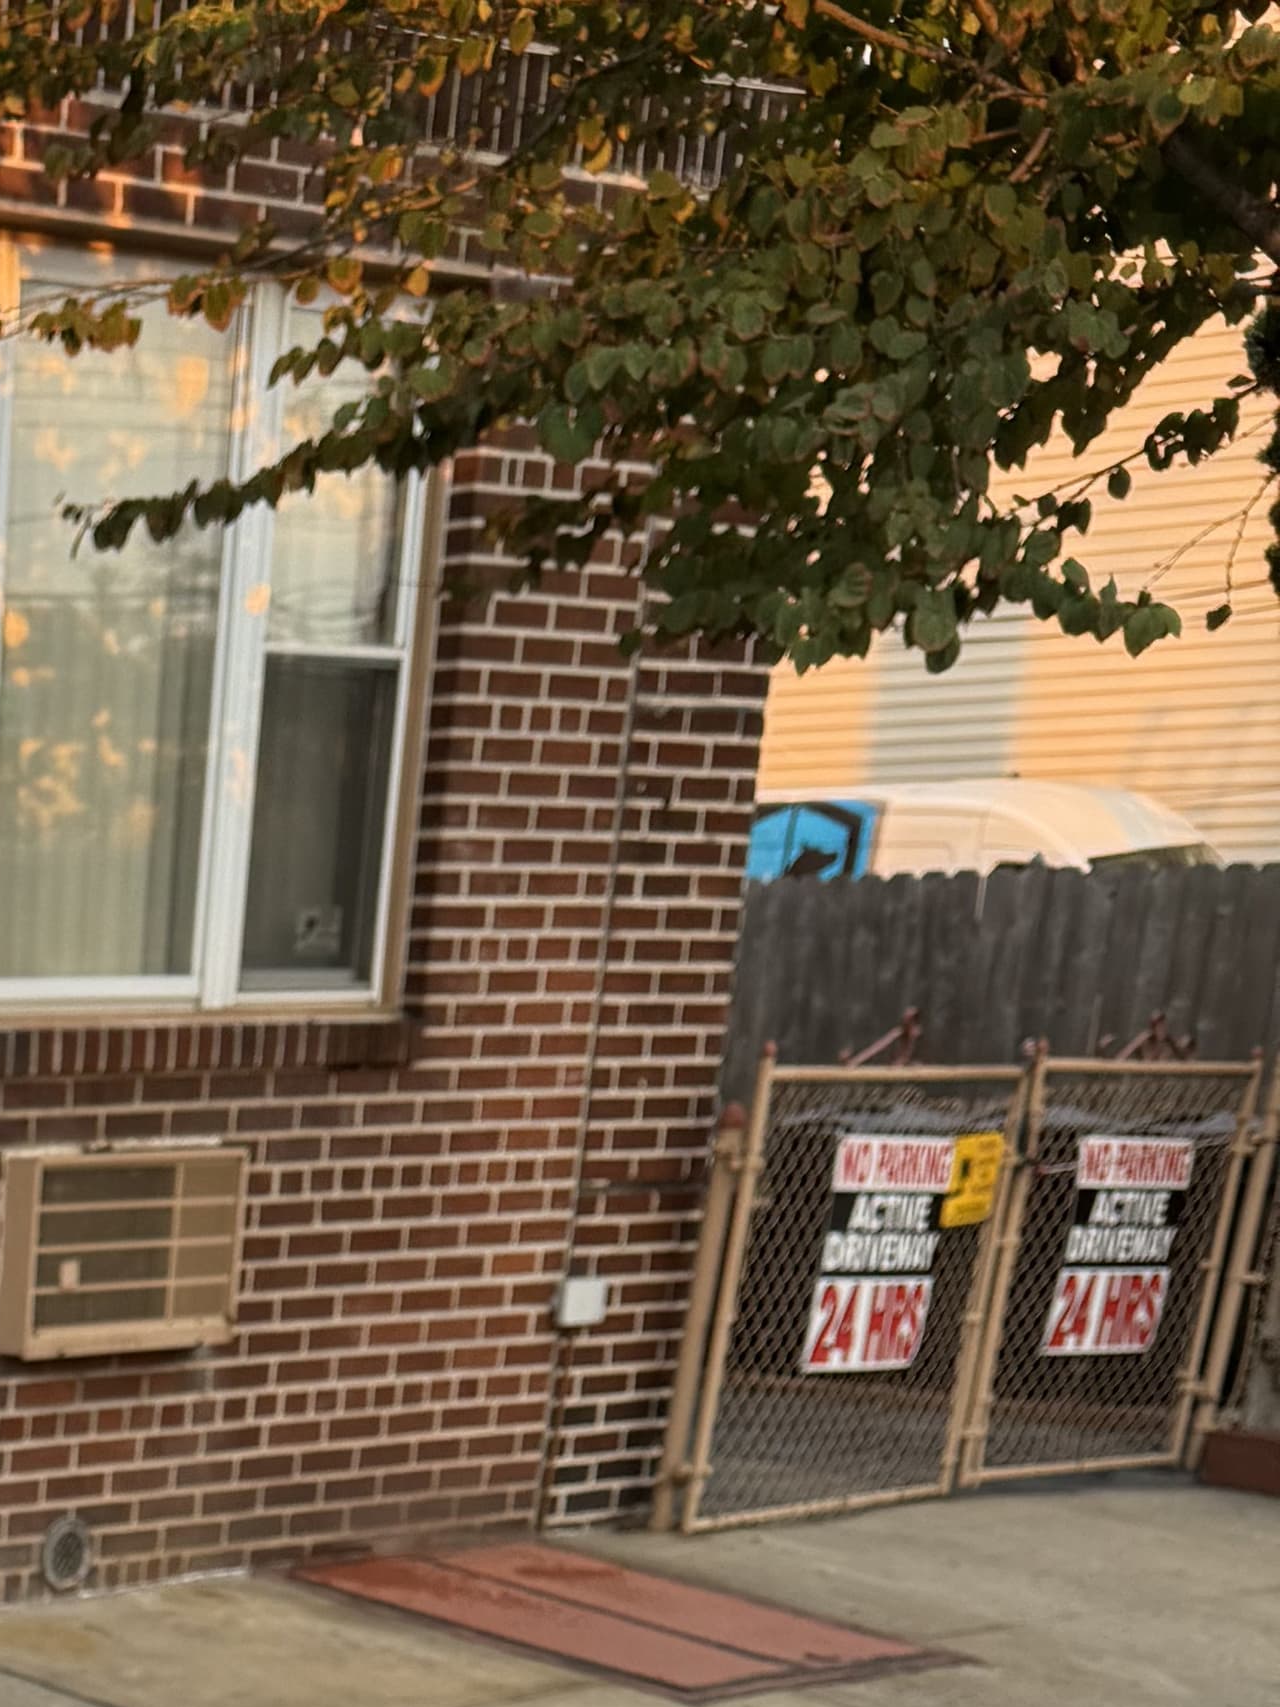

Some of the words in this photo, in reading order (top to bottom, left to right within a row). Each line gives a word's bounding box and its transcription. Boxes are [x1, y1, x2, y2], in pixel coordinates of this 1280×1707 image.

[842, 1141, 871, 1184] NO
[877, 1142, 952, 1186] PARKING
[1085, 1141, 1111, 1182] NO
[1116, 1142, 1191, 1183] PARKING
[848, 1194, 934, 1233] ACTIVE
[1089, 1190, 1172, 1226] ACTIVE
[820, 1231, 940, 1272] DRIVEWAY
[1064, 1226, 1179, 1263] DRIVEWAY
[809, 1283, 861, 1364] 24
[862, 1283, 925, 1363] HRS
[1048, 1273, 1099, 1348] 24
[1095, 1272, 1162, 1347] HRS
